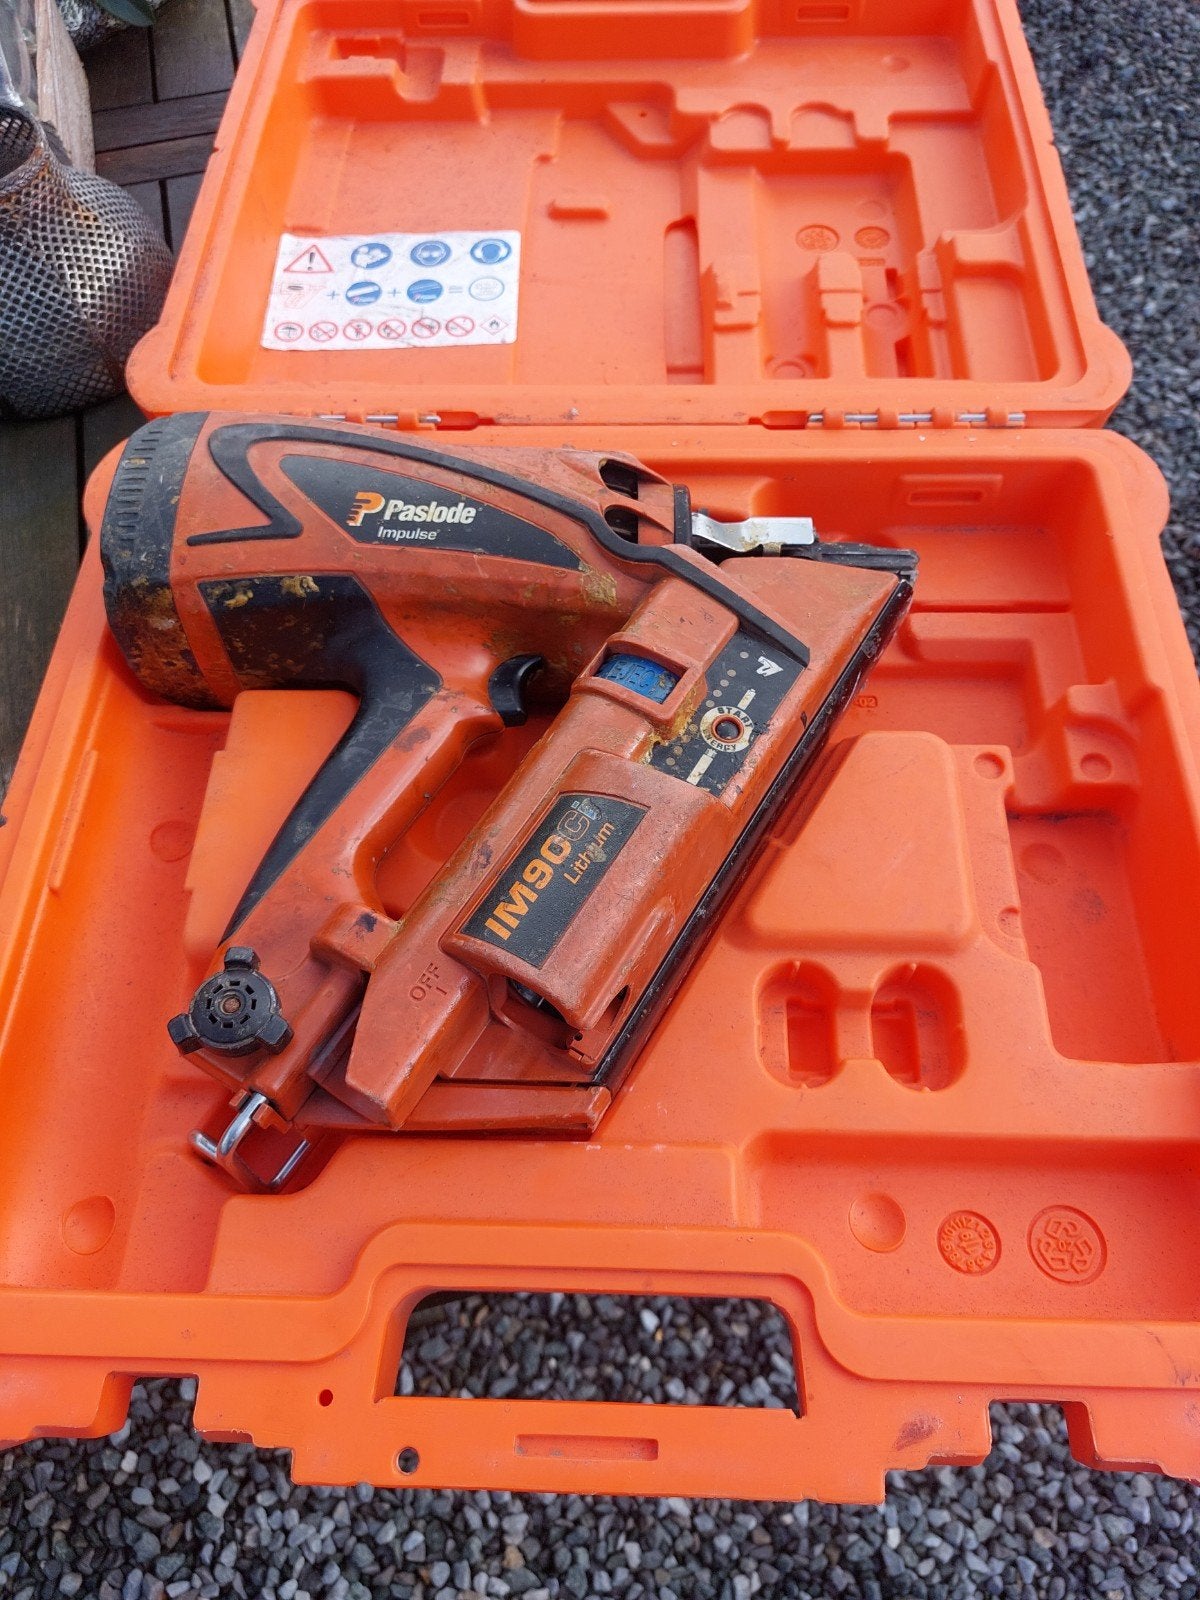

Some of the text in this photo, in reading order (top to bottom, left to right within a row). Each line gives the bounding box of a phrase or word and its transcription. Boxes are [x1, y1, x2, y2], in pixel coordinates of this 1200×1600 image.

[383, 499, 477, 525] Paslode
[377, 526, 438, 541] Impulse
[410, 962, 440, 1001] OFF
